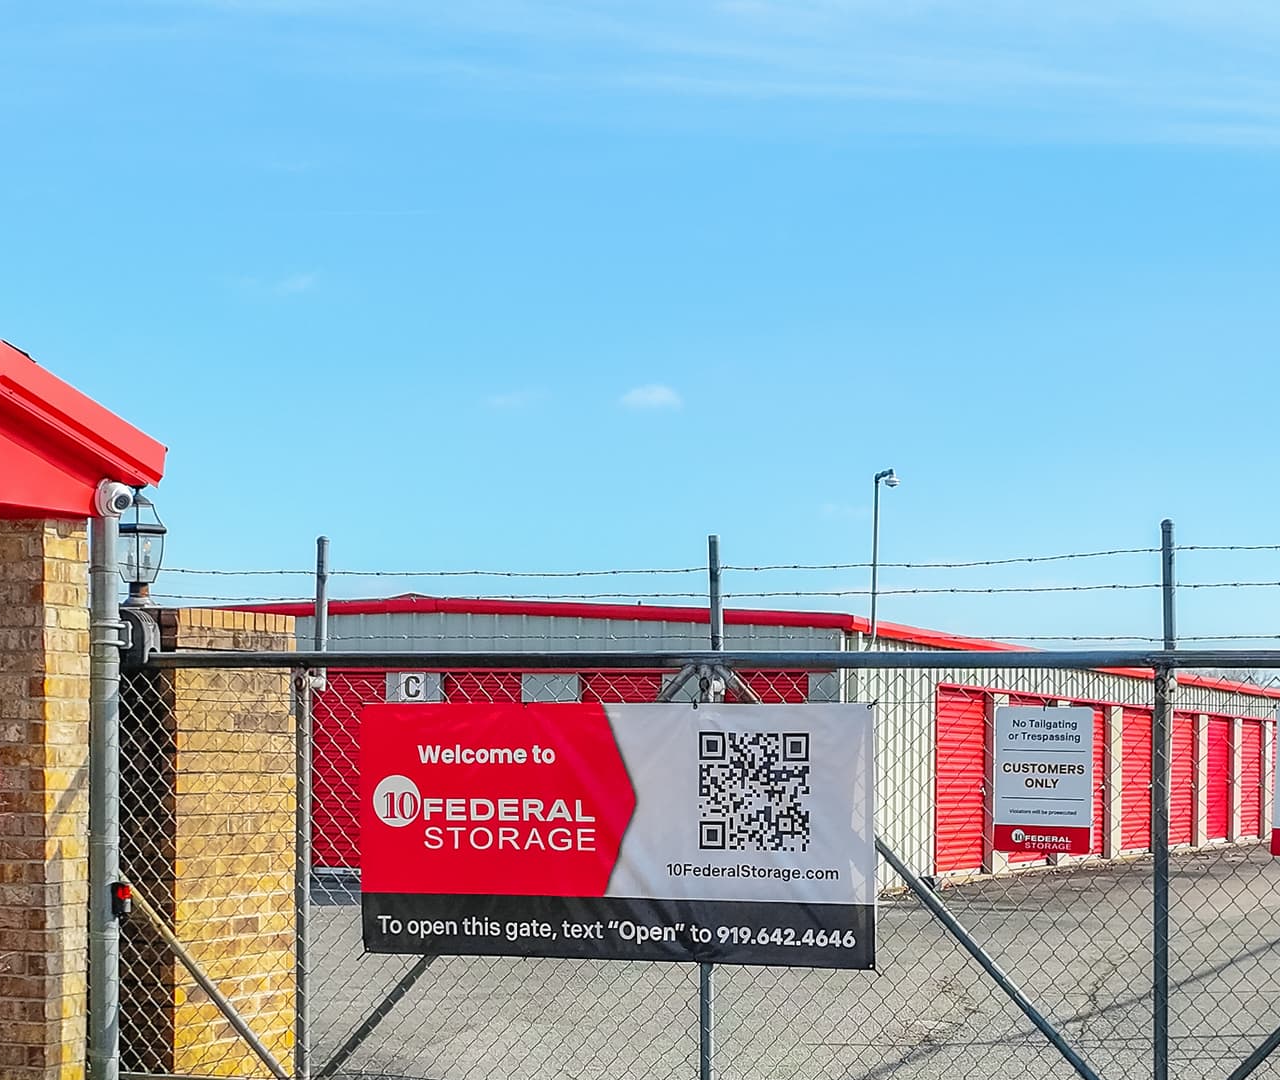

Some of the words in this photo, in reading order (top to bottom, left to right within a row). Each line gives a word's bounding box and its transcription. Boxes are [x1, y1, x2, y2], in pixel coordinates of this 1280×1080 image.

[404, 675, 421, 698] C
[1012, 719, 1026, 728] No
[1029, 720, 1078, 731] Tailgating
[1008, 732, 1019, 741] or
[1021, 731, 1081, 743] Trespassing
[417, 744, 527, 765] Welcome
[532, 745, 556, 765] to
[1002, 762, 1085, 775] CUSTOMERS
[1024, 777, 1059, 789] ONLY
[382, 790, 416, 820] 10
[423, 798, 596, 823] FEDERAL
[423, 827, 596, 852] STORAGE
[1024, 834, 1072, 843] FEDERAL
[1024, 842, 1072, 851] STORAGE
[666, 862, 839, 882] 10FederalStorage.com
[378, 915, 402, 935] To
[406, 919, 458, 941] open
[462, 916, 501, 938] this
[505, 920, 558, 943] gate,
[562, 921, 603, 940] text
[690, 926, 713, 944] to
[716, 926, 856, 949] 919.642.4646
